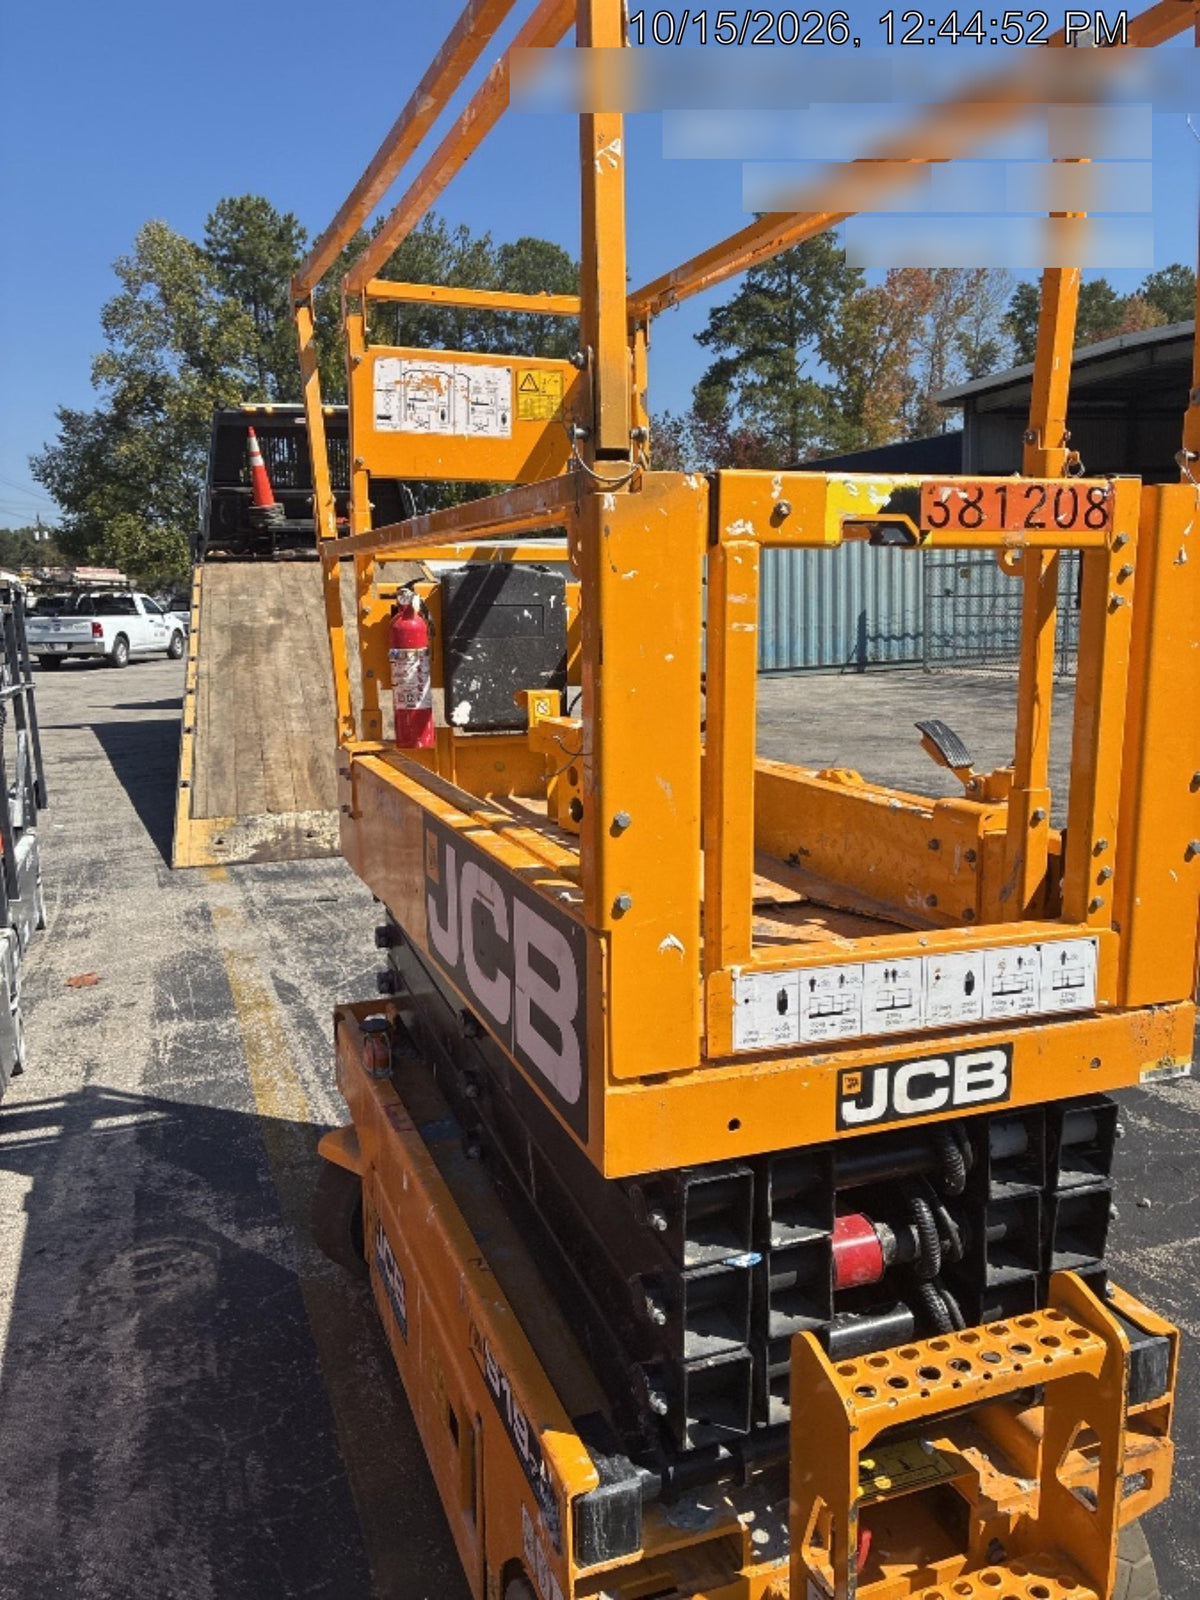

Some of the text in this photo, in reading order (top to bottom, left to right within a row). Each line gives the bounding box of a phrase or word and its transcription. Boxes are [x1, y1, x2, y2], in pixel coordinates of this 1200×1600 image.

[926, 485, 1111, 529] 381208
[427, 843, 583, 1105] JCB
[841, 1049, 1008, 1124] JCB
